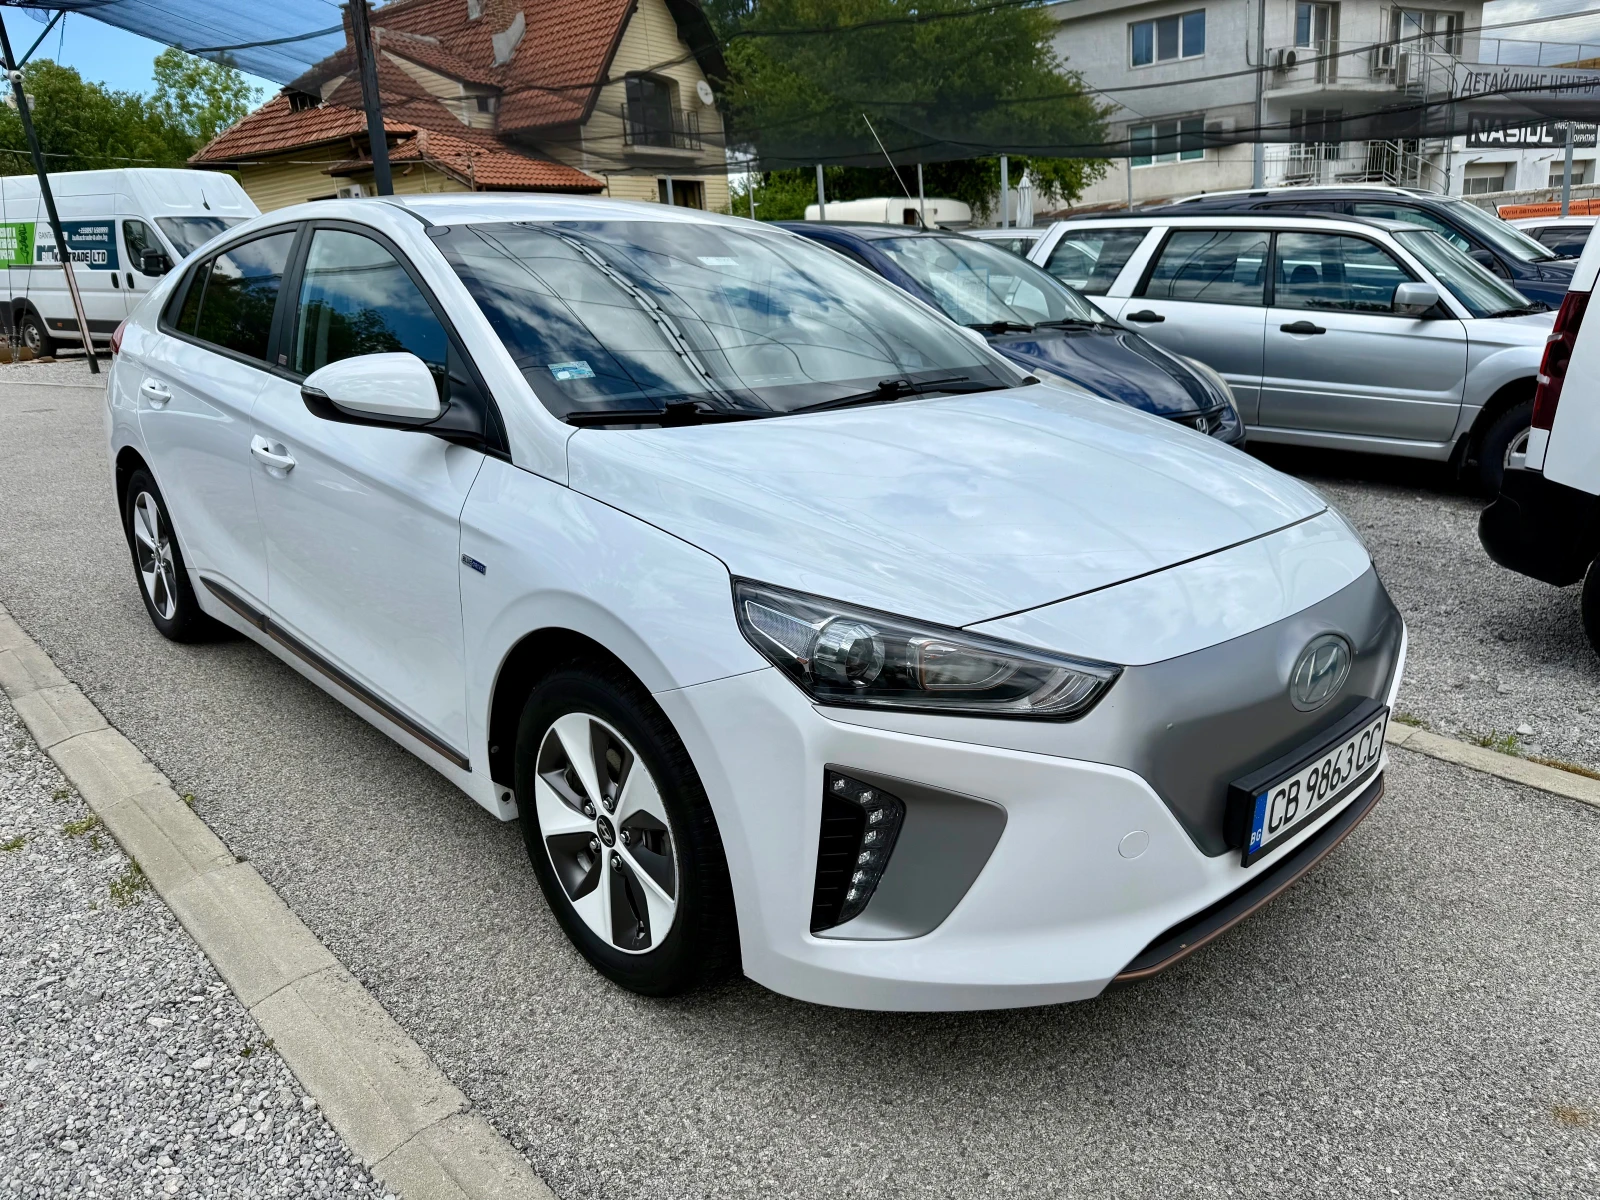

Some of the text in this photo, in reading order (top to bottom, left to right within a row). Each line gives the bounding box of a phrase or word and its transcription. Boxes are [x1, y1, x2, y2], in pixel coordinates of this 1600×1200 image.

[1461, 68, 1547, 97] ДЕТАЙЛИНГ
[92, 251, 107, 262] LTD
[1268, 721, 1382, 834] CB 9863 CC
[1250, 828, 1262, 846] BG
